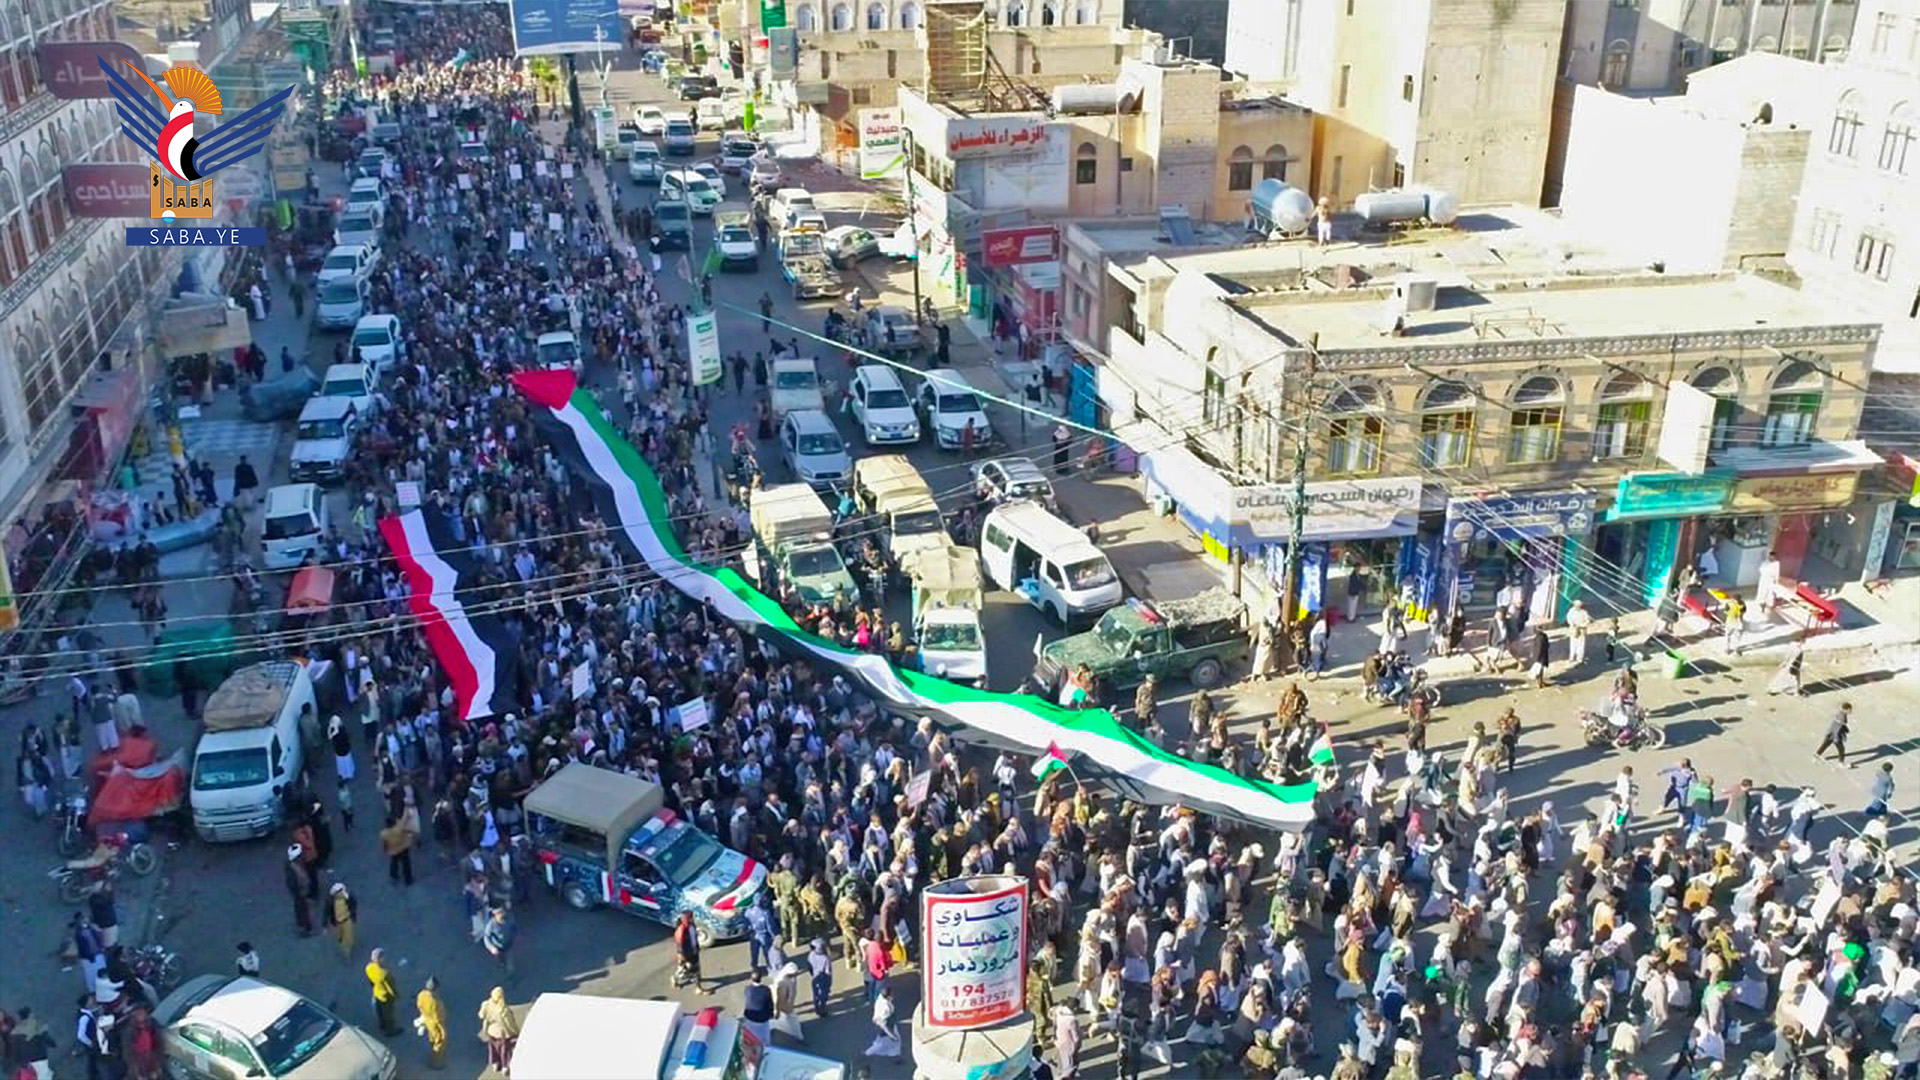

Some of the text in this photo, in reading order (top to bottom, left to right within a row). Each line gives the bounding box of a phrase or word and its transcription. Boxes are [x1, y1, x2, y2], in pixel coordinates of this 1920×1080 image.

[950, 125, 1045, 151] الزهراء للأسنان
[75, 179, 152, 206] لسياحي
[1368, 485, 1415, 504] رضوان
[1535, 498, 1586, 513] رضوان
[937, 926, 1019, 951] وعمليات
[936, 950, 1019, 976] مرور ذمار
[951, 983, 985, 998] 194
